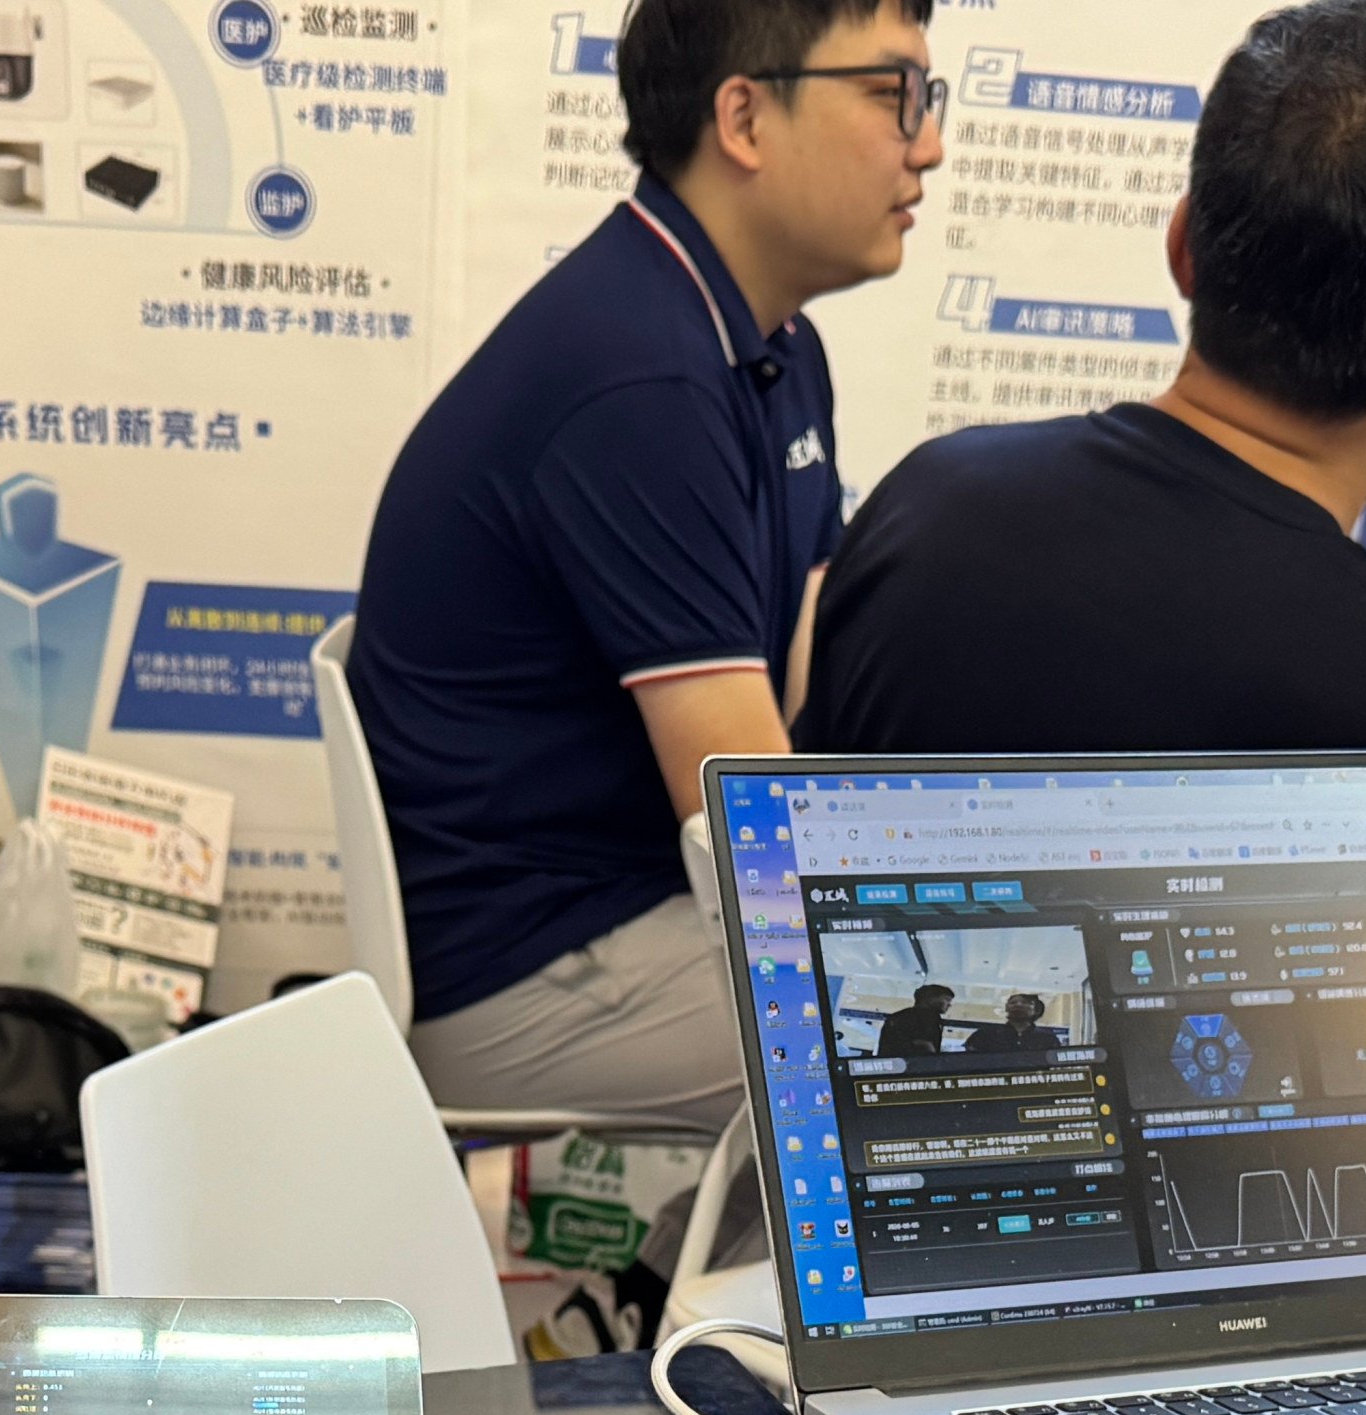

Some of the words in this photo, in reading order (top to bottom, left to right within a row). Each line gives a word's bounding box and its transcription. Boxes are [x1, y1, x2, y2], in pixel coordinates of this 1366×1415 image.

[299, 7, 419, 42] 巡检监测
[262, 60, 449, 96] 医疗级检测终端
[958, 46, 1024, 107] 2
[1027, 80, 1176, 118] 语音情感分析
[200, 260, 372, 299] 健康风险评估
[1165, 876, 1225, 893] 实时检测
[1218, 1317, 1267, 1332] HUAWEI
